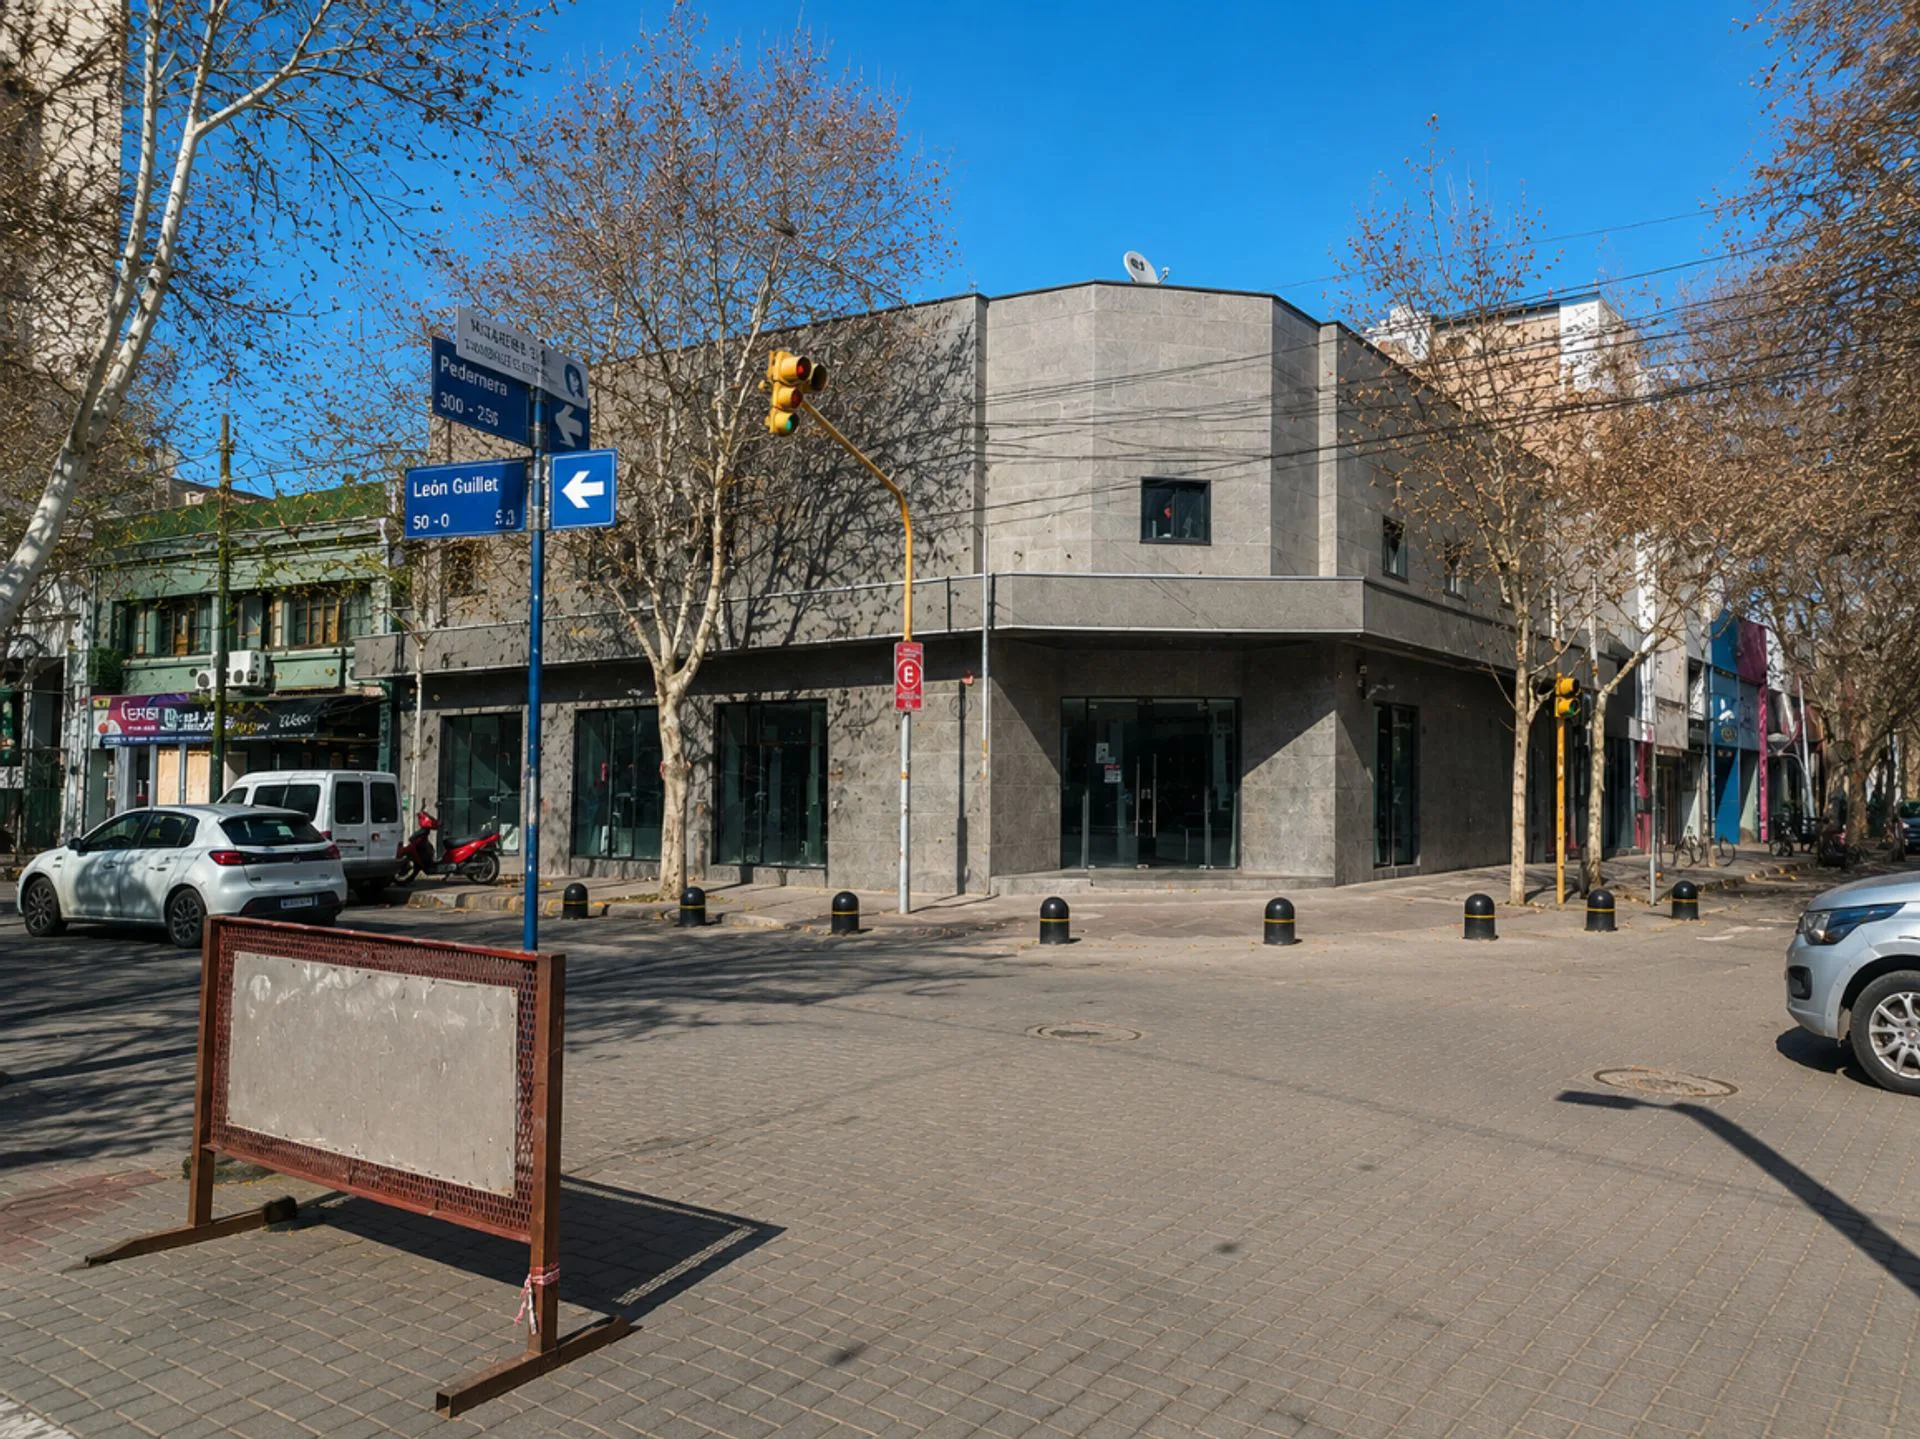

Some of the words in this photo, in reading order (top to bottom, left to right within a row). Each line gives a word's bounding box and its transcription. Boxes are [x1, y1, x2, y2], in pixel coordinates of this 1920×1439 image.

[440, 354, 508, 397] Pedernera
[440, 391, 464, 414] 300
[413, 479, 449, 498] León
[452, 476, 499, 495] Guillet
[903, 665, 914, 683] E
